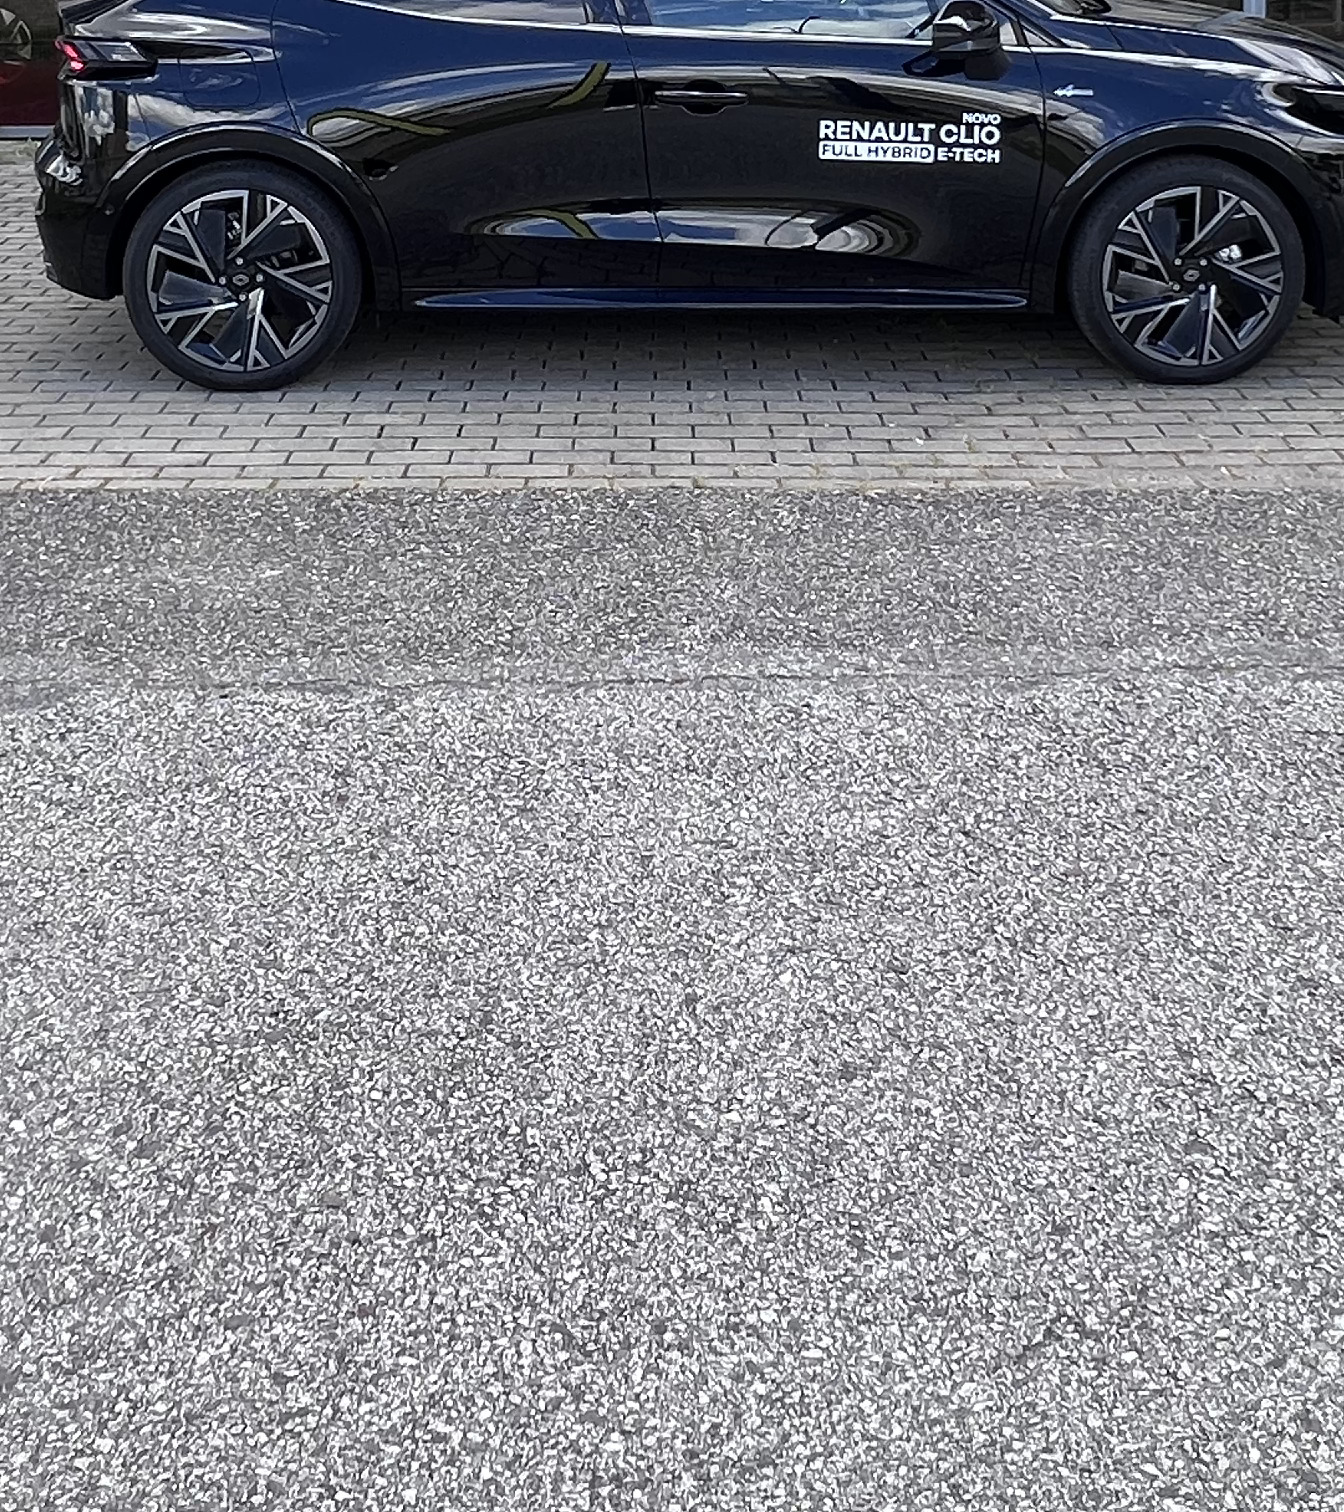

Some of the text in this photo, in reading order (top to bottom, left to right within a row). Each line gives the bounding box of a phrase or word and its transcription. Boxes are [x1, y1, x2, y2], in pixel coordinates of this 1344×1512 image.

[962, 112, 1001, 124] NOVO
[818, 119, 1001, 145] RENAULT CLIO
[822, 143, 1000, 163] FULL HYBRID E-TECH
